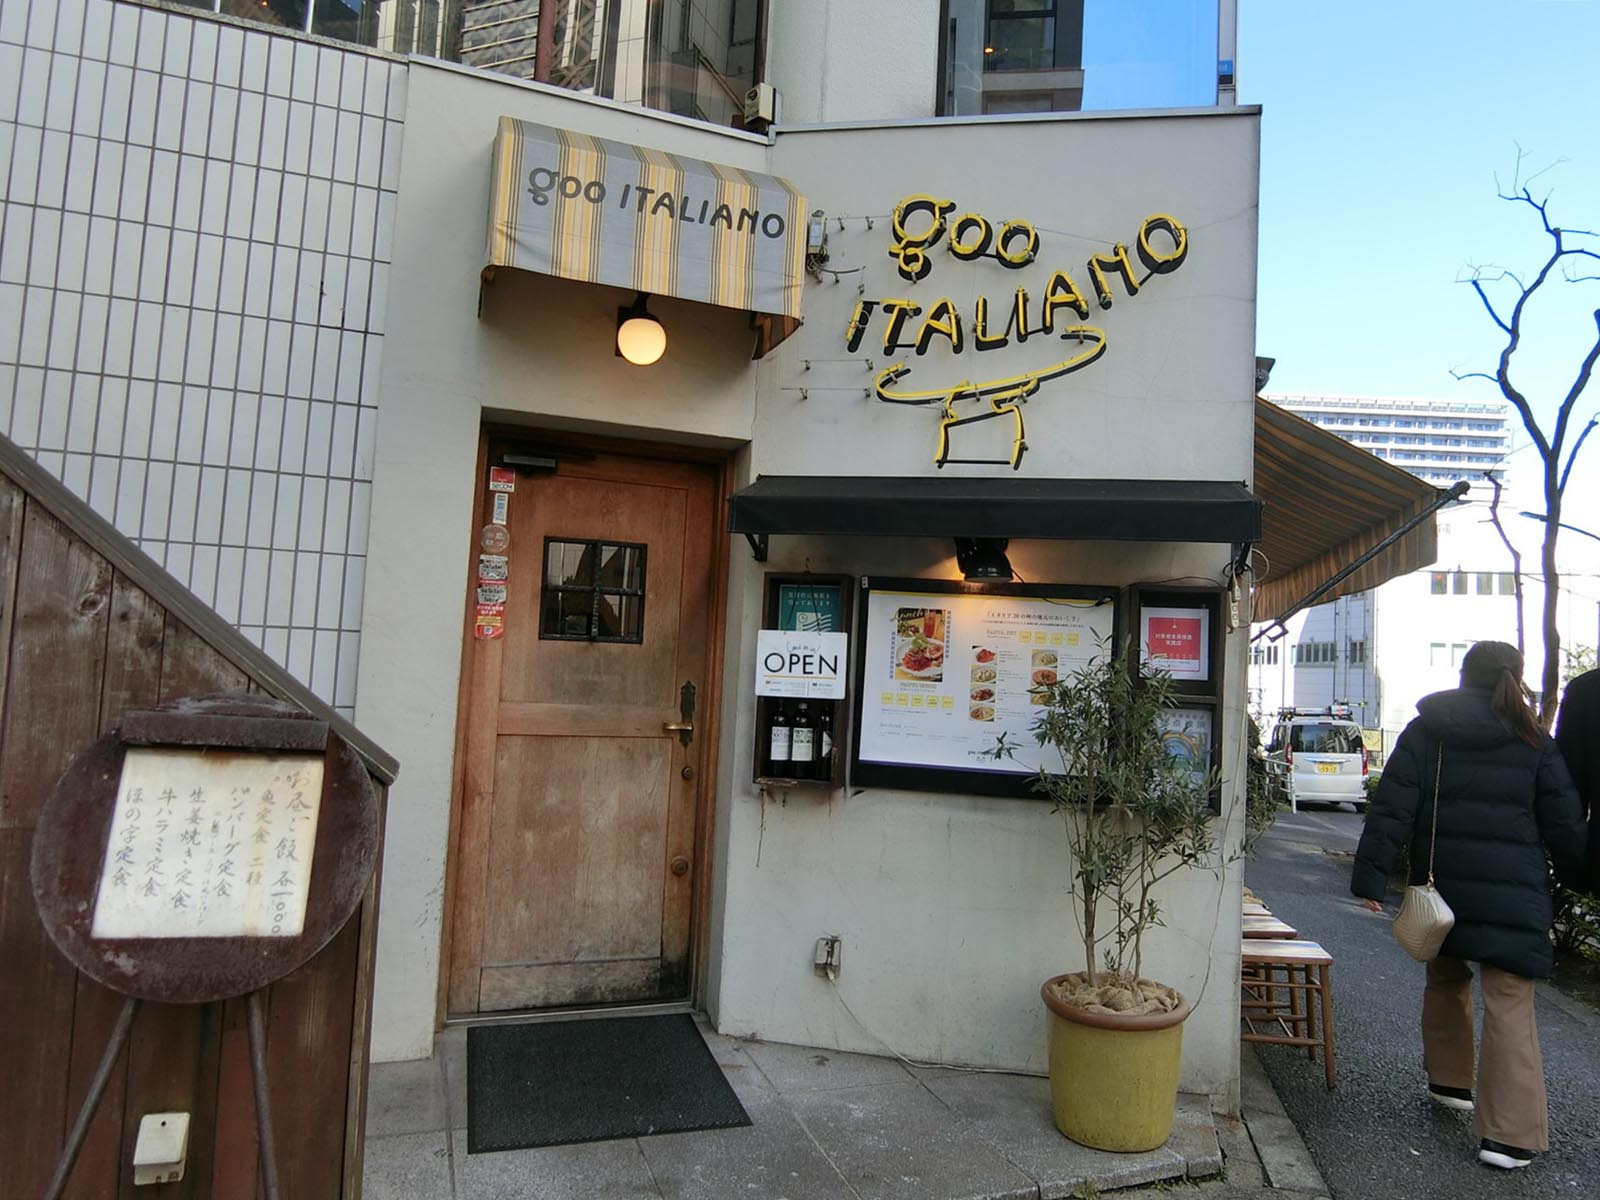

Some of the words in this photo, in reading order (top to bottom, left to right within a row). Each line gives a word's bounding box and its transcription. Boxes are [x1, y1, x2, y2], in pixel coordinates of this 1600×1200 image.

[528, 167, 606, 206] goo
[619, 184, 785, 239] ITALIANO
[889, 194, 1040, 283] goo
[845, 213, 1188, 356] ITALIANO
[764, 652, 838, 675] OPEN
[141, 786, 179, 898] 牛ハラミ定食
[170, 786, 207, 909] 生姜焼き定食
